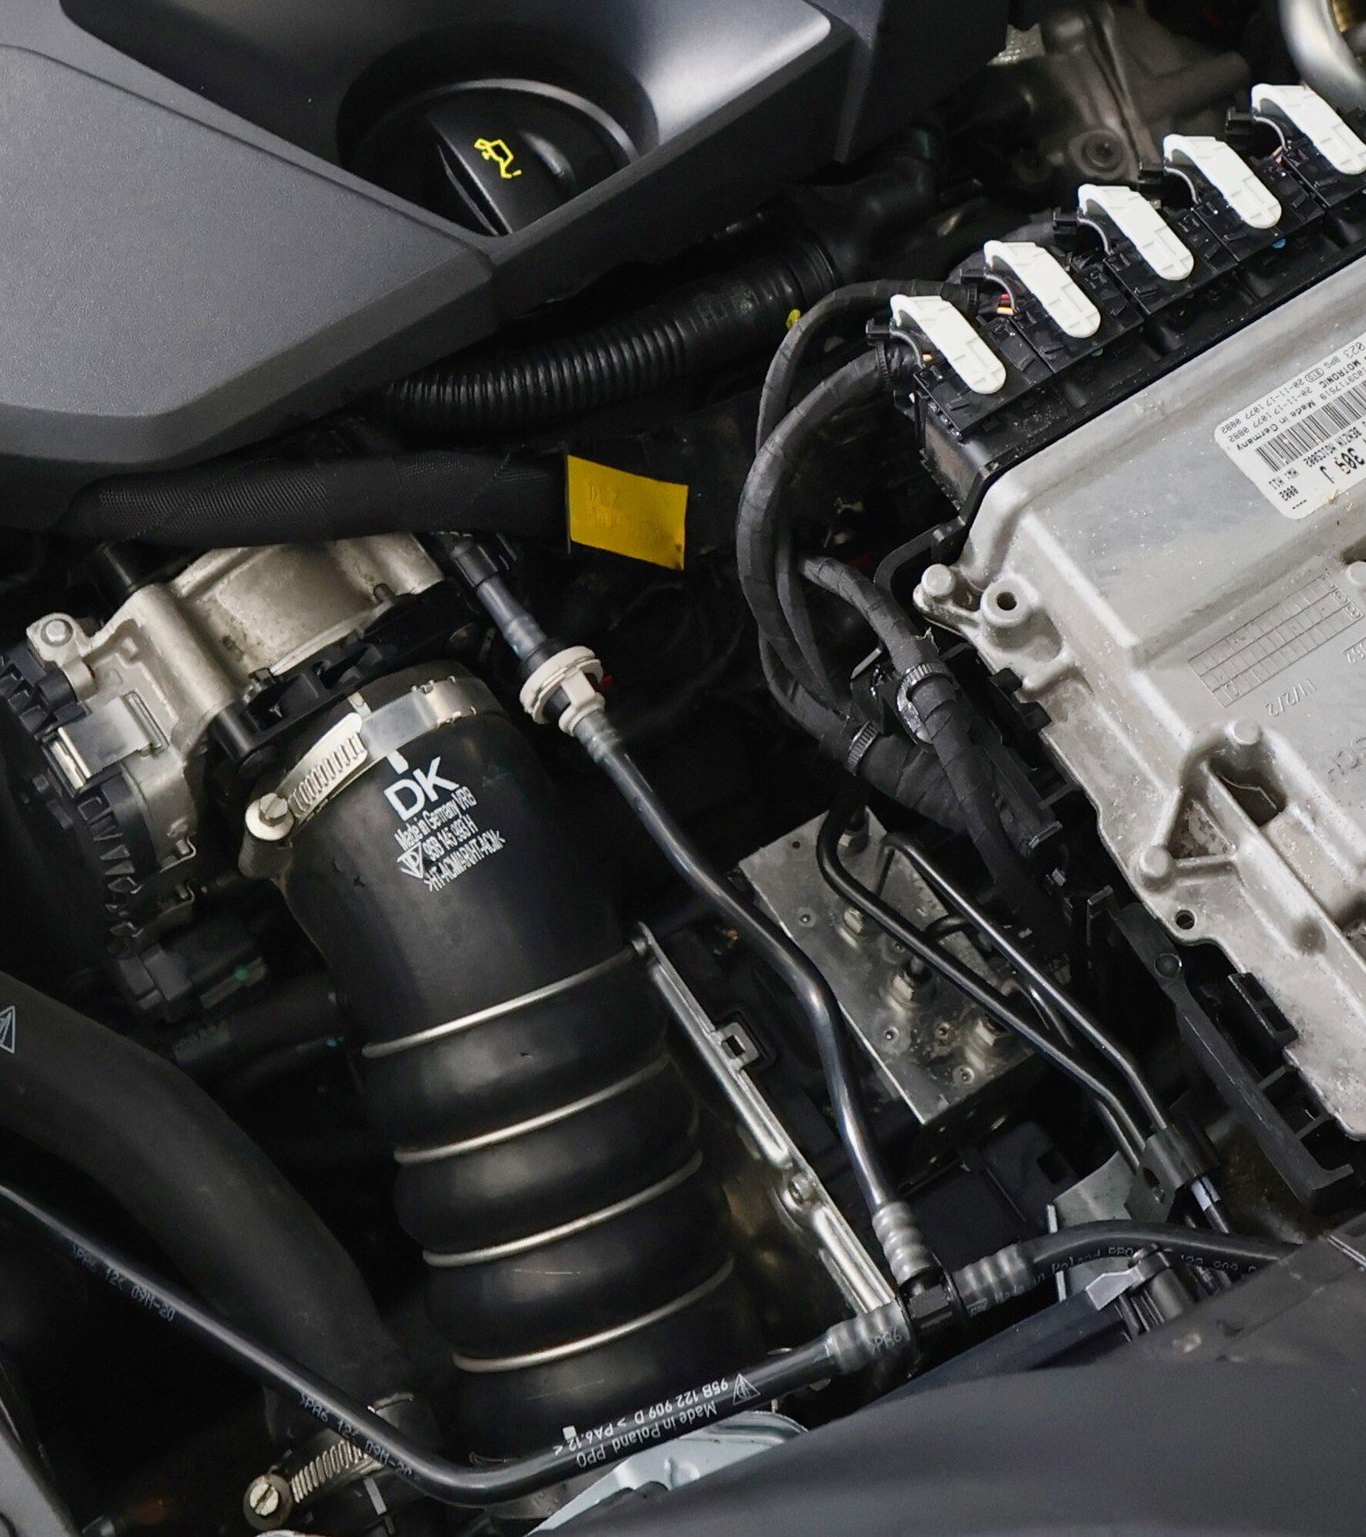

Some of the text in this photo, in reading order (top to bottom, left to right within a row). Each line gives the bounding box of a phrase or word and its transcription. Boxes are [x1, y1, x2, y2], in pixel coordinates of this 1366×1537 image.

[1341, 339, 1366, 361] 023
[1316, 357, 1362, 390] MOTRONIC
[1263, 377, 1305, 407] 20-11-17
[1271, 385, 1313, 416] 20-11-17
[1235, 398, 1316, 452] Made in Germany
[1333, 425, 1361, 448] BENZIN
[1317, 464, 1334, 486] J
[1332, 445, 1366, 477] 309
[383, 756, 460, 820] DK
[415, 816, 433, 837] in
[423, 800, 463, 830] Germany
[394, 823, 422, 852] Made
[437, 828, 459, 851] 145
[463, 814, 479, 834] H
[673, 1387, 700, 1407] 122
[700, 1376, 729, 1397] 95B
[631, 1409, 646, 1424] D
[646, 1398, 673, 1419] 909
[676, 1398, 718, 1427] Made
[609, 1420, 663, 1454] Poland
[661, 1414, 678, 1433] in
